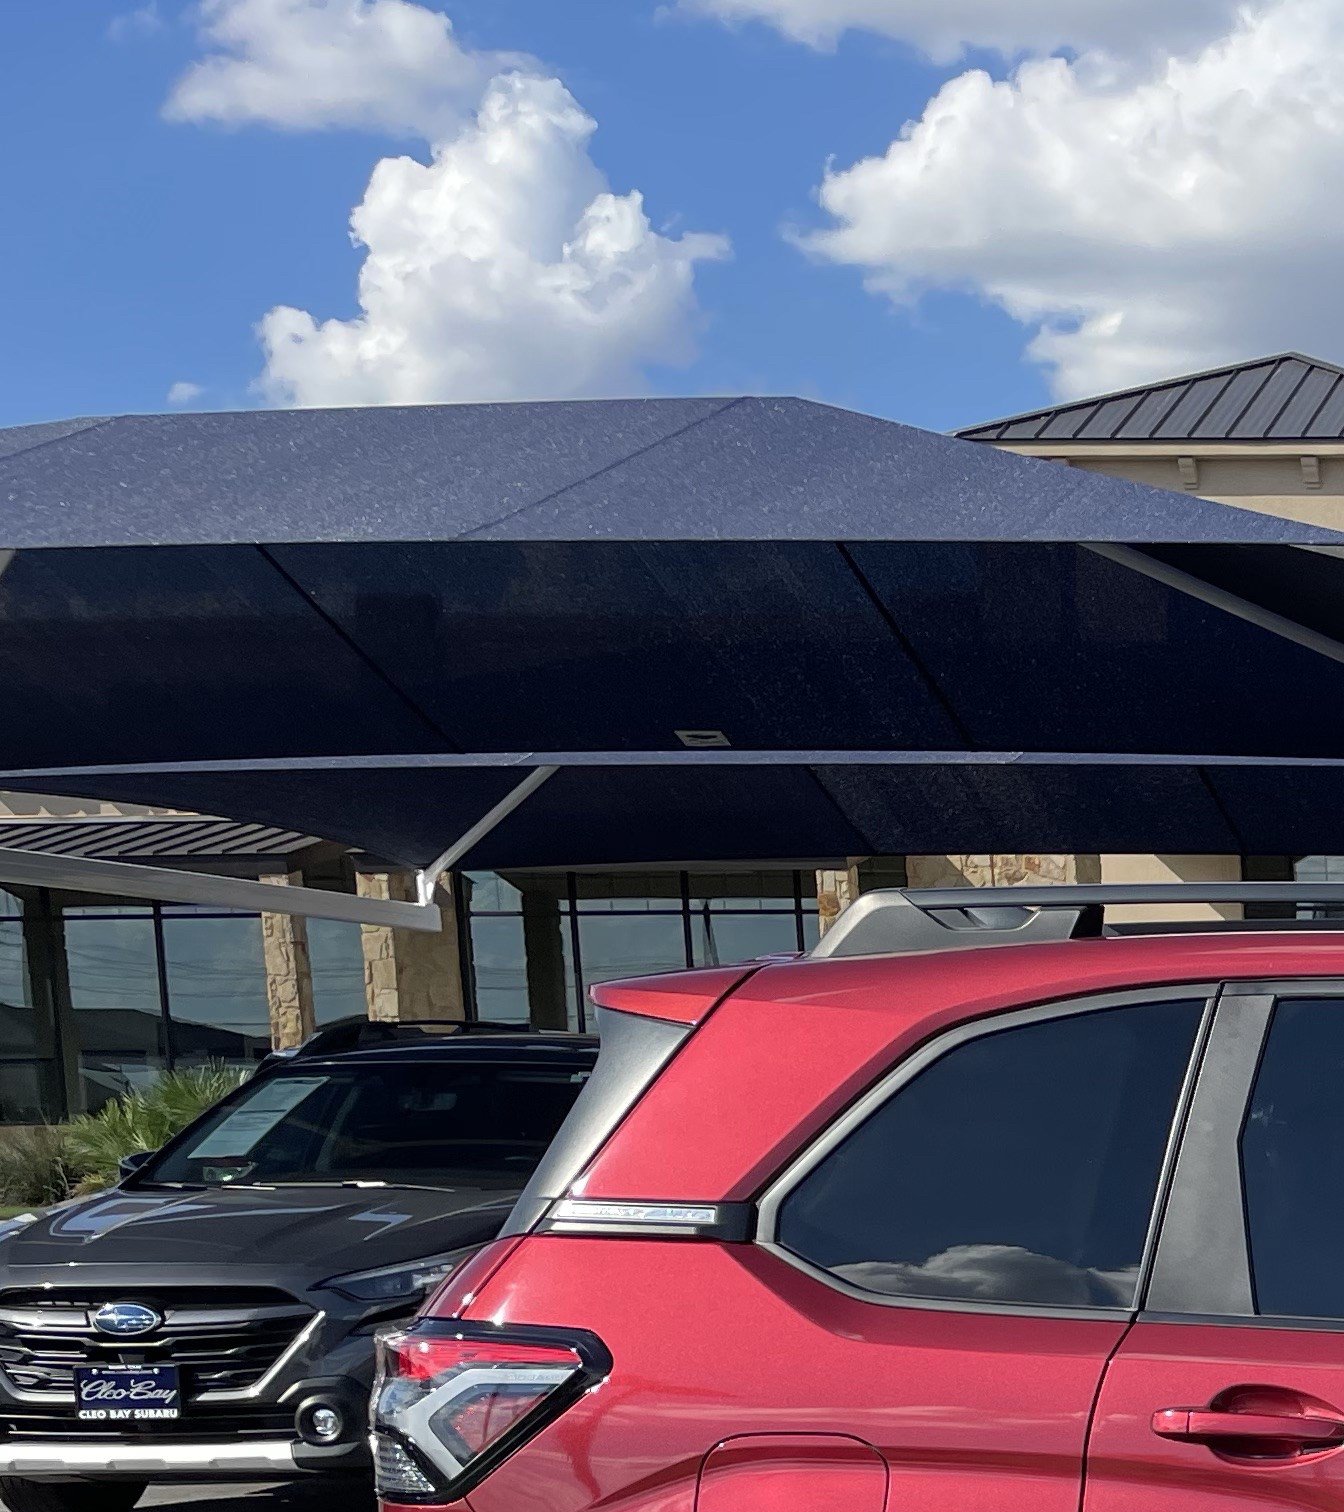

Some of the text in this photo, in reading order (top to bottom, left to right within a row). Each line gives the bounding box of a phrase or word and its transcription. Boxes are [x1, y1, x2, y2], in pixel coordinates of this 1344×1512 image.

[80, 1379, 178, 1404] Cleo Bay
[79, 1408, 178, 1419] CLEO BAY SUBARU
